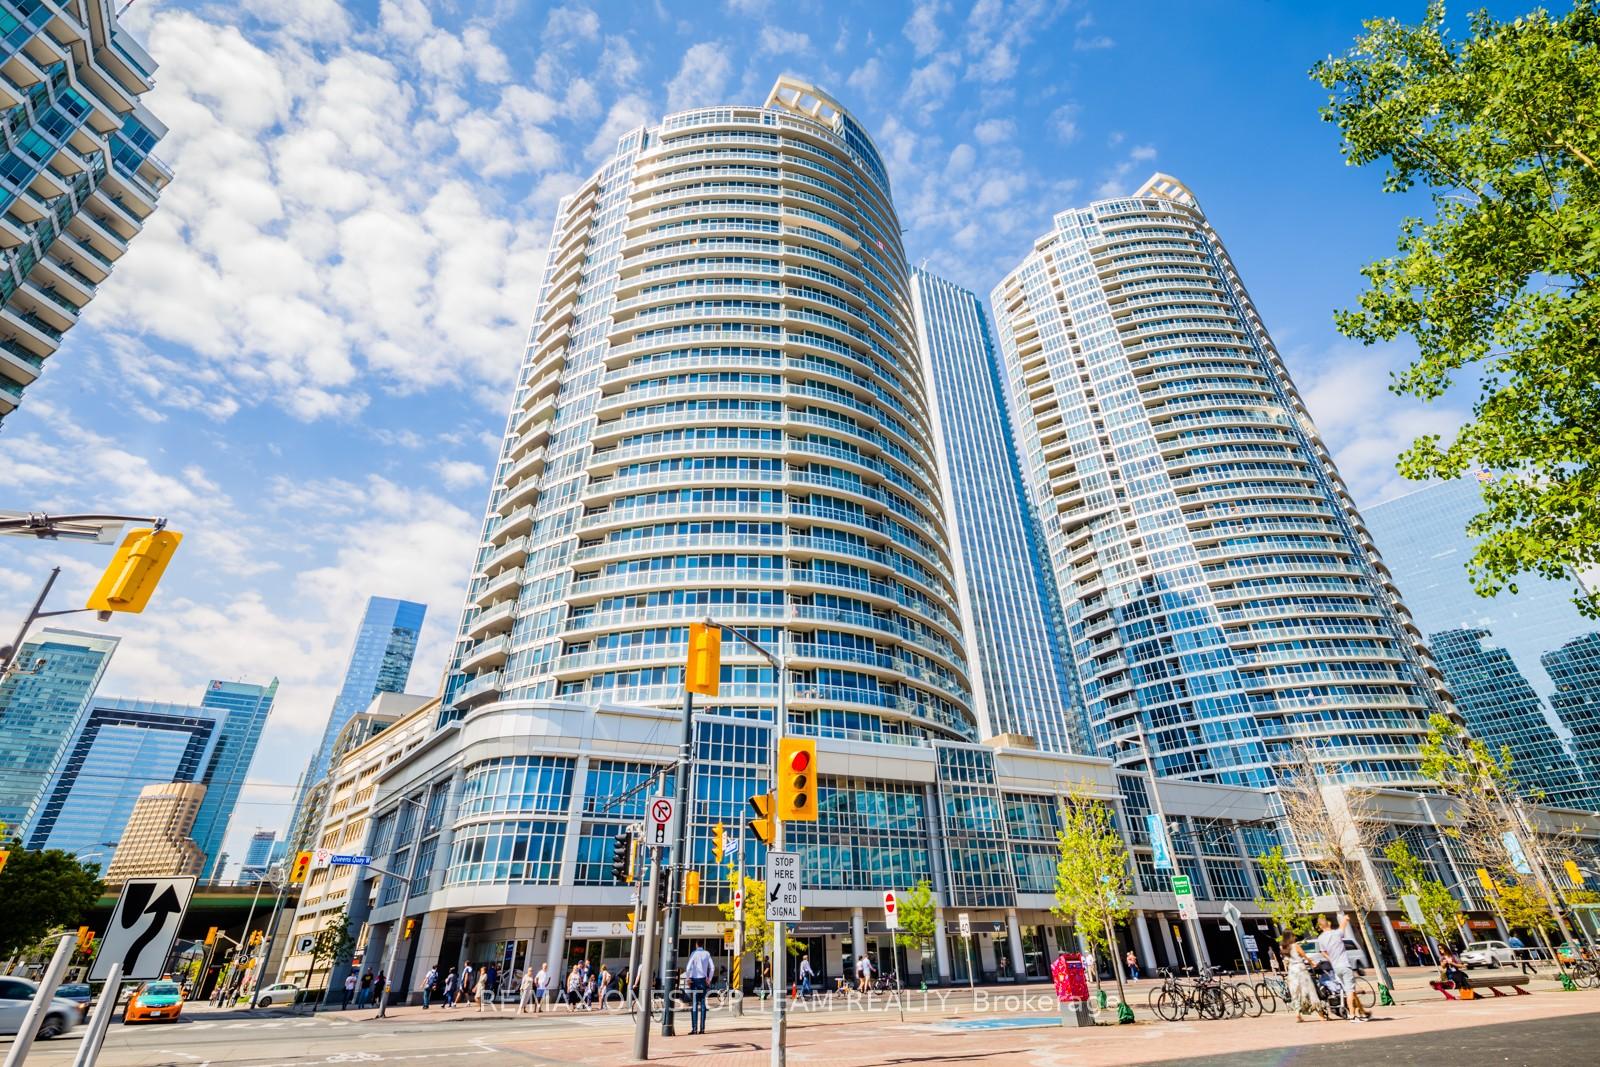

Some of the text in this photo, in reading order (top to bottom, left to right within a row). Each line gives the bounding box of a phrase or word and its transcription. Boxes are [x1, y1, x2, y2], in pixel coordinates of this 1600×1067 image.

[352, 856, 366, 865] Quay
[775, 857, 794, 866] STOP
[775, 870, 794, 879] HERE
[788, 882, 797, 891] ON
[784, 895, 797, 903] RED
[772, 907, 797, 916] SIGNAL
[301, 939, 312, 951] P
